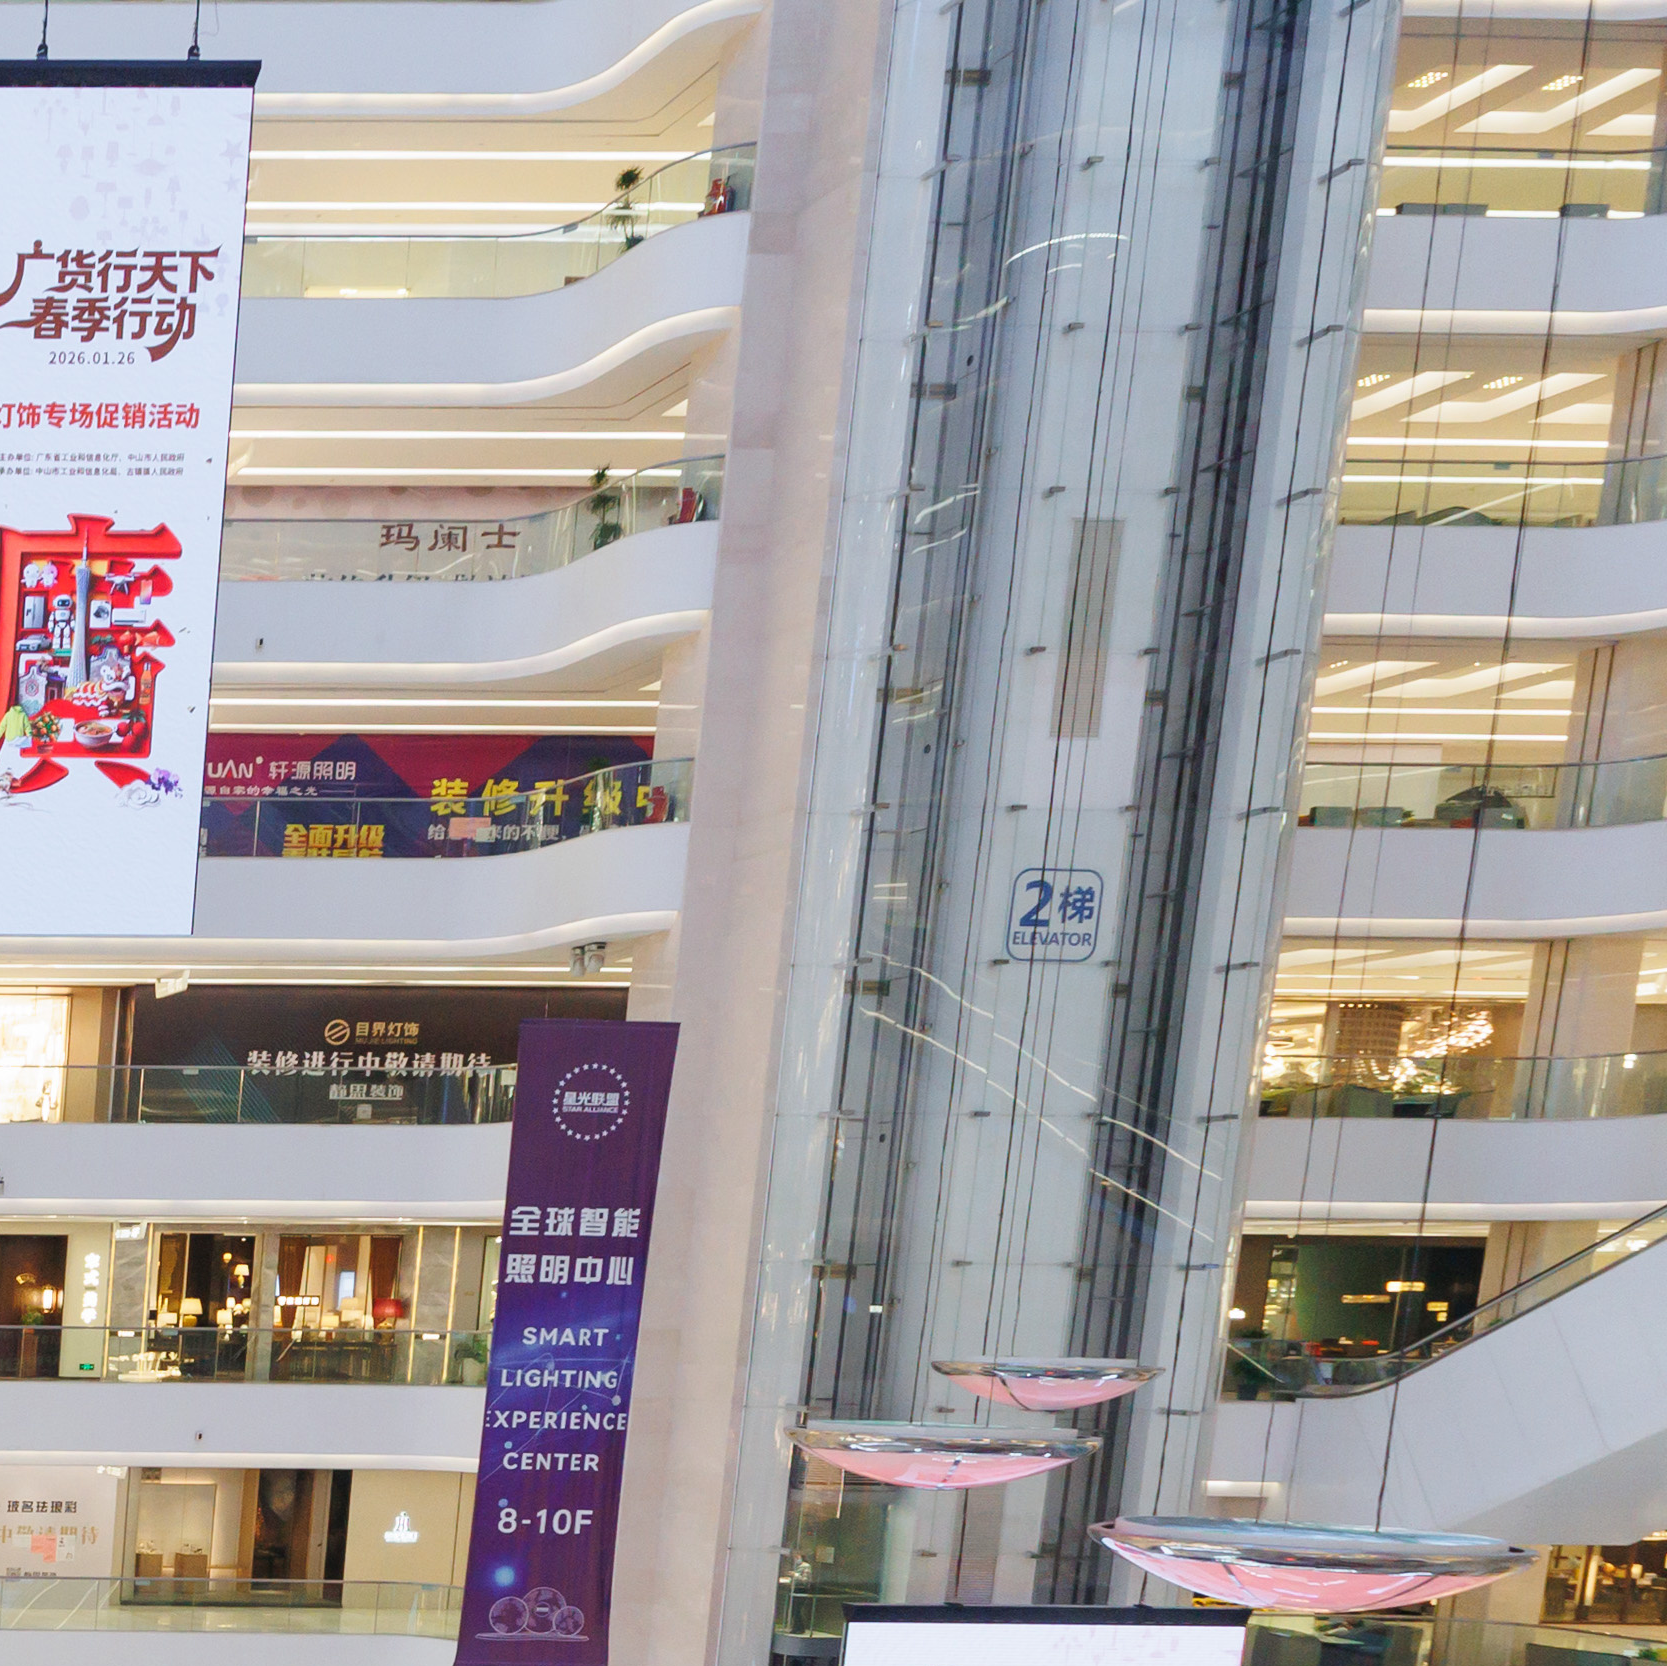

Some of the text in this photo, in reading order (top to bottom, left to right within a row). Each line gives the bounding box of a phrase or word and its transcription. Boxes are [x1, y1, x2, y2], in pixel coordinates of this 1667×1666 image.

[49, 351, 135, 365] 2026.01.26
[269, 761, 357, 780] 轩源照明
[284, 823, 385, 847] 全面升级
[1020, 880, 1095, 928] 2梯
[1012, 931, 1092, 946] ELEVATOR
[355, 1022, 419, 1037] 目界灯饰
[247, 1050, 491, 1077] 装修进行中敬请期待
[563, 1091, 620, 1106] 星光联盟
[510, 1207, 641, 1237] 全球智能
[506, 1254, 634, 1285] 照明中心
[522, 1327, 610, 1348] SMART
[500, 1369, 618, 1389] LIGHTING
[503, 1452, 600, 1472] CENTER
[498, 1508, 594, 1535] 8-10F
